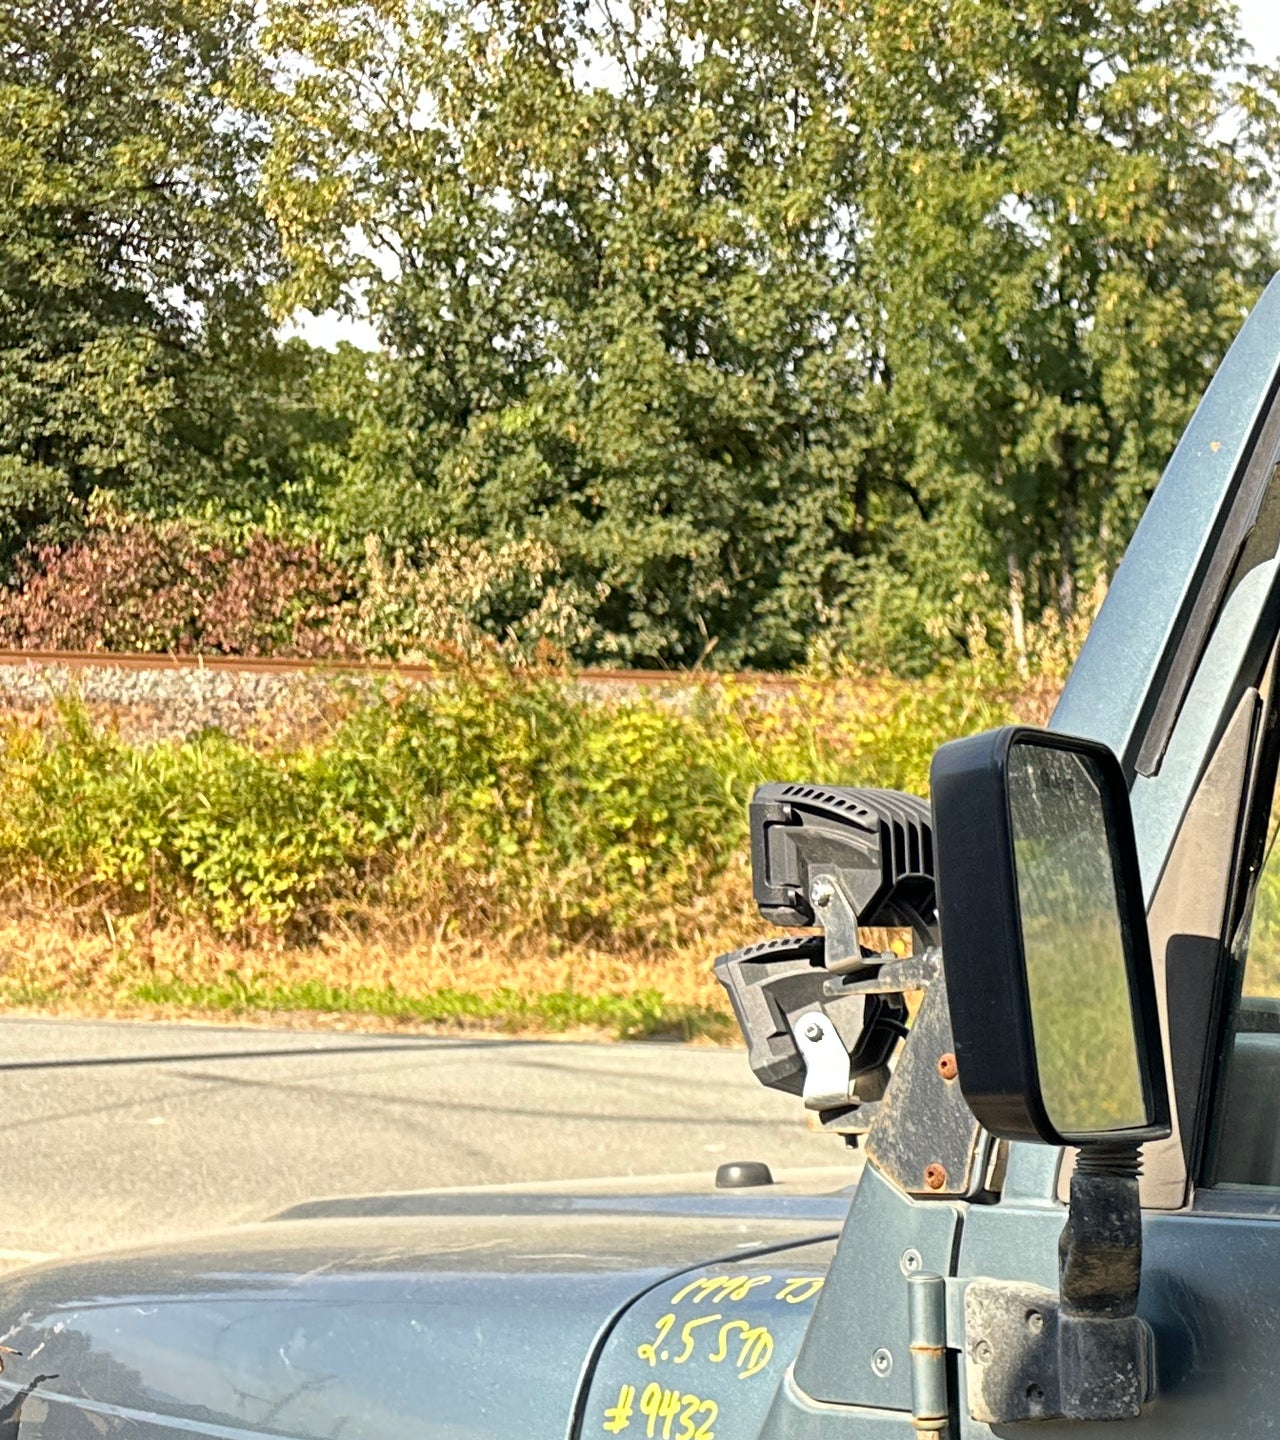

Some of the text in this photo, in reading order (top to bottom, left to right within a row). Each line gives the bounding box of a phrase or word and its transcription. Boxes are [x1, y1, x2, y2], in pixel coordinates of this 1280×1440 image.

[671, 1275, 826, 1304] 1998 TJ
[637, 1313, 774, 1380] 2.5 STD
